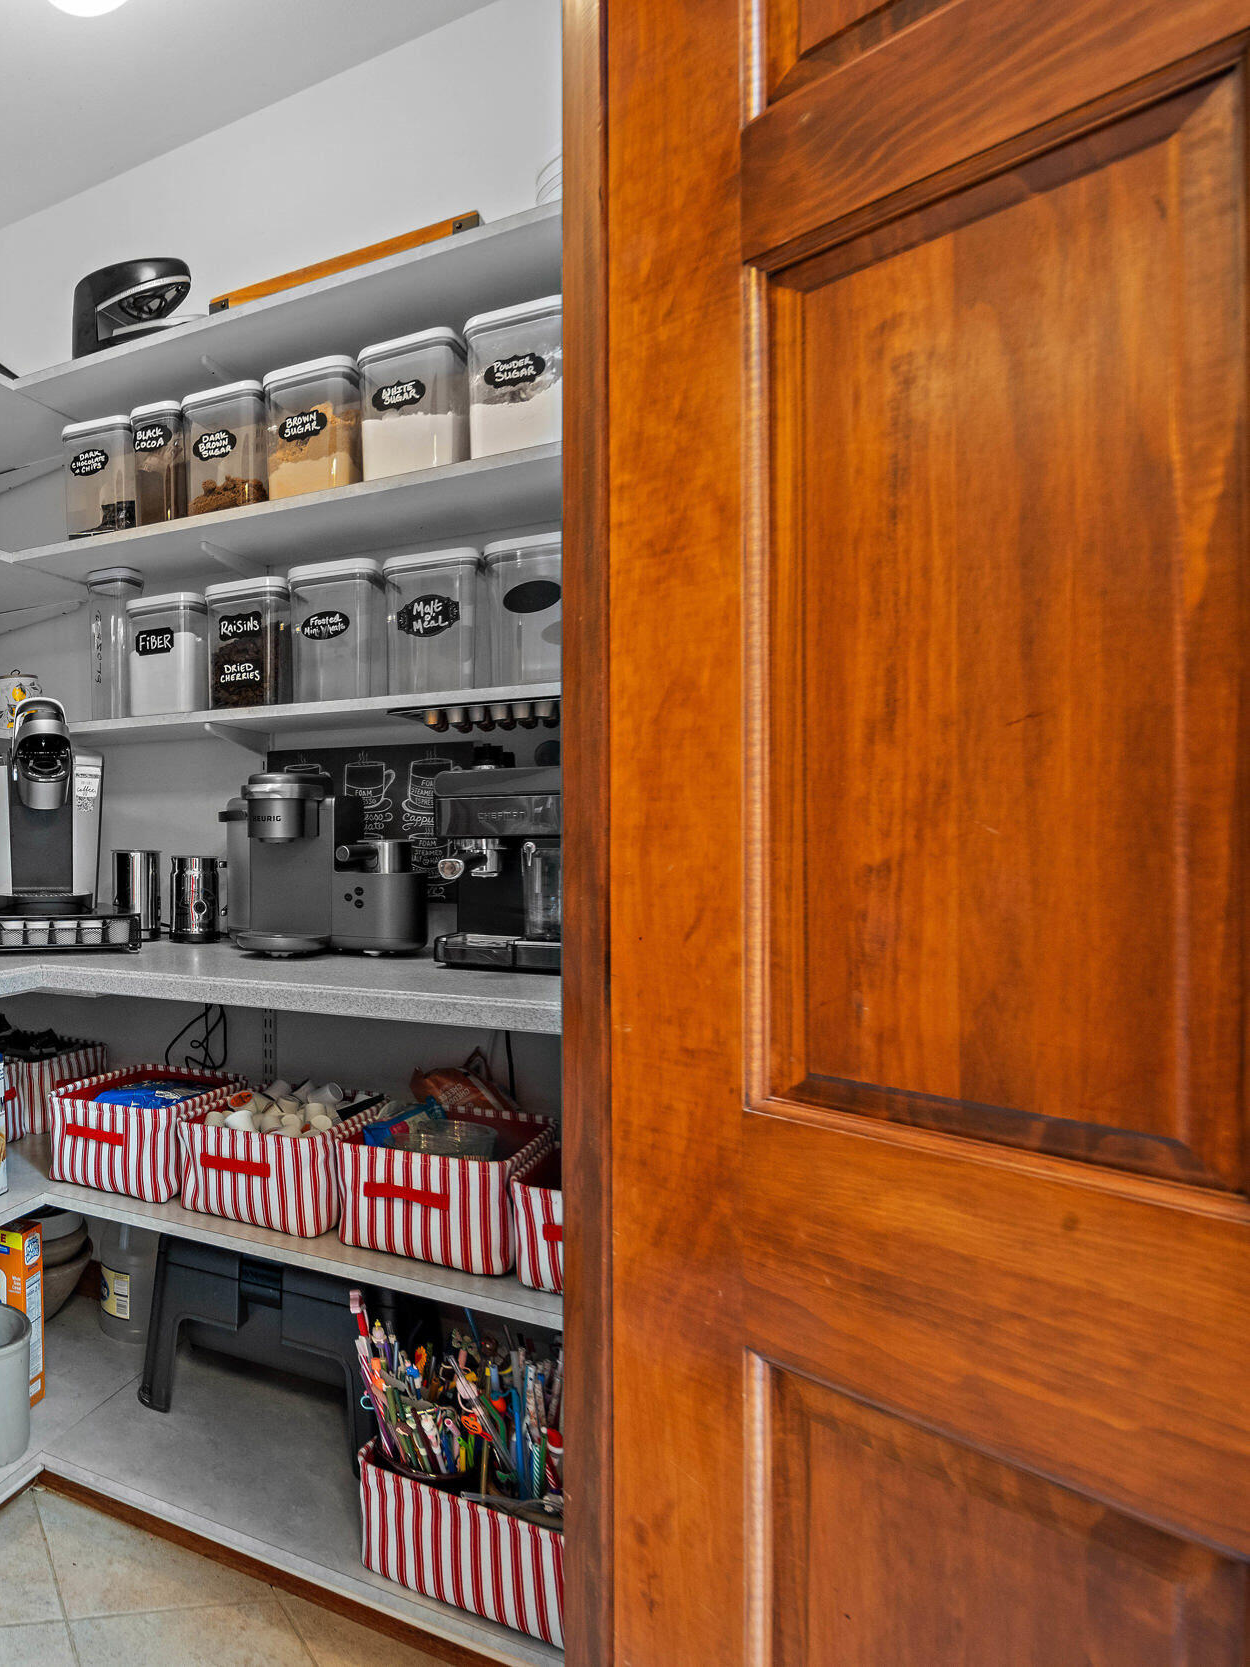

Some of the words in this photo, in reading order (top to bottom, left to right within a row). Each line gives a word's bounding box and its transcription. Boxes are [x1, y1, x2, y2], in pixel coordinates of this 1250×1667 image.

[493, 357, 534, 373] POWDER
[494, 366, 537, 382] SUGAR
[381, 382, 416, 401] WHITE
[384, 391, 420, 405] SUGAR
[286, 413, 318, 429] BROWN
[136, 427, 164, 441] BLACK
[284, 421, 320, 438] SUGAR
[135, 437, 164, 450] COCOA
[202, 432, 228, 443] DARK
[198, 439, 229, 452] BROWN
[201, 445, 232, 458] SUGAR
[80, 450, 102, 461] DARK
[72, 456, 106, 469] CHOCOLATE
[81, 464, 102, 477] CHIPS
[412, 600, 443, 616] Malt
[310, 614, 342, 626] Frosted
[304, 626, 319, 637] Mini
[220, 671, 261, 683] CHERRIES
[355, 789, 372, 797] FOAM
